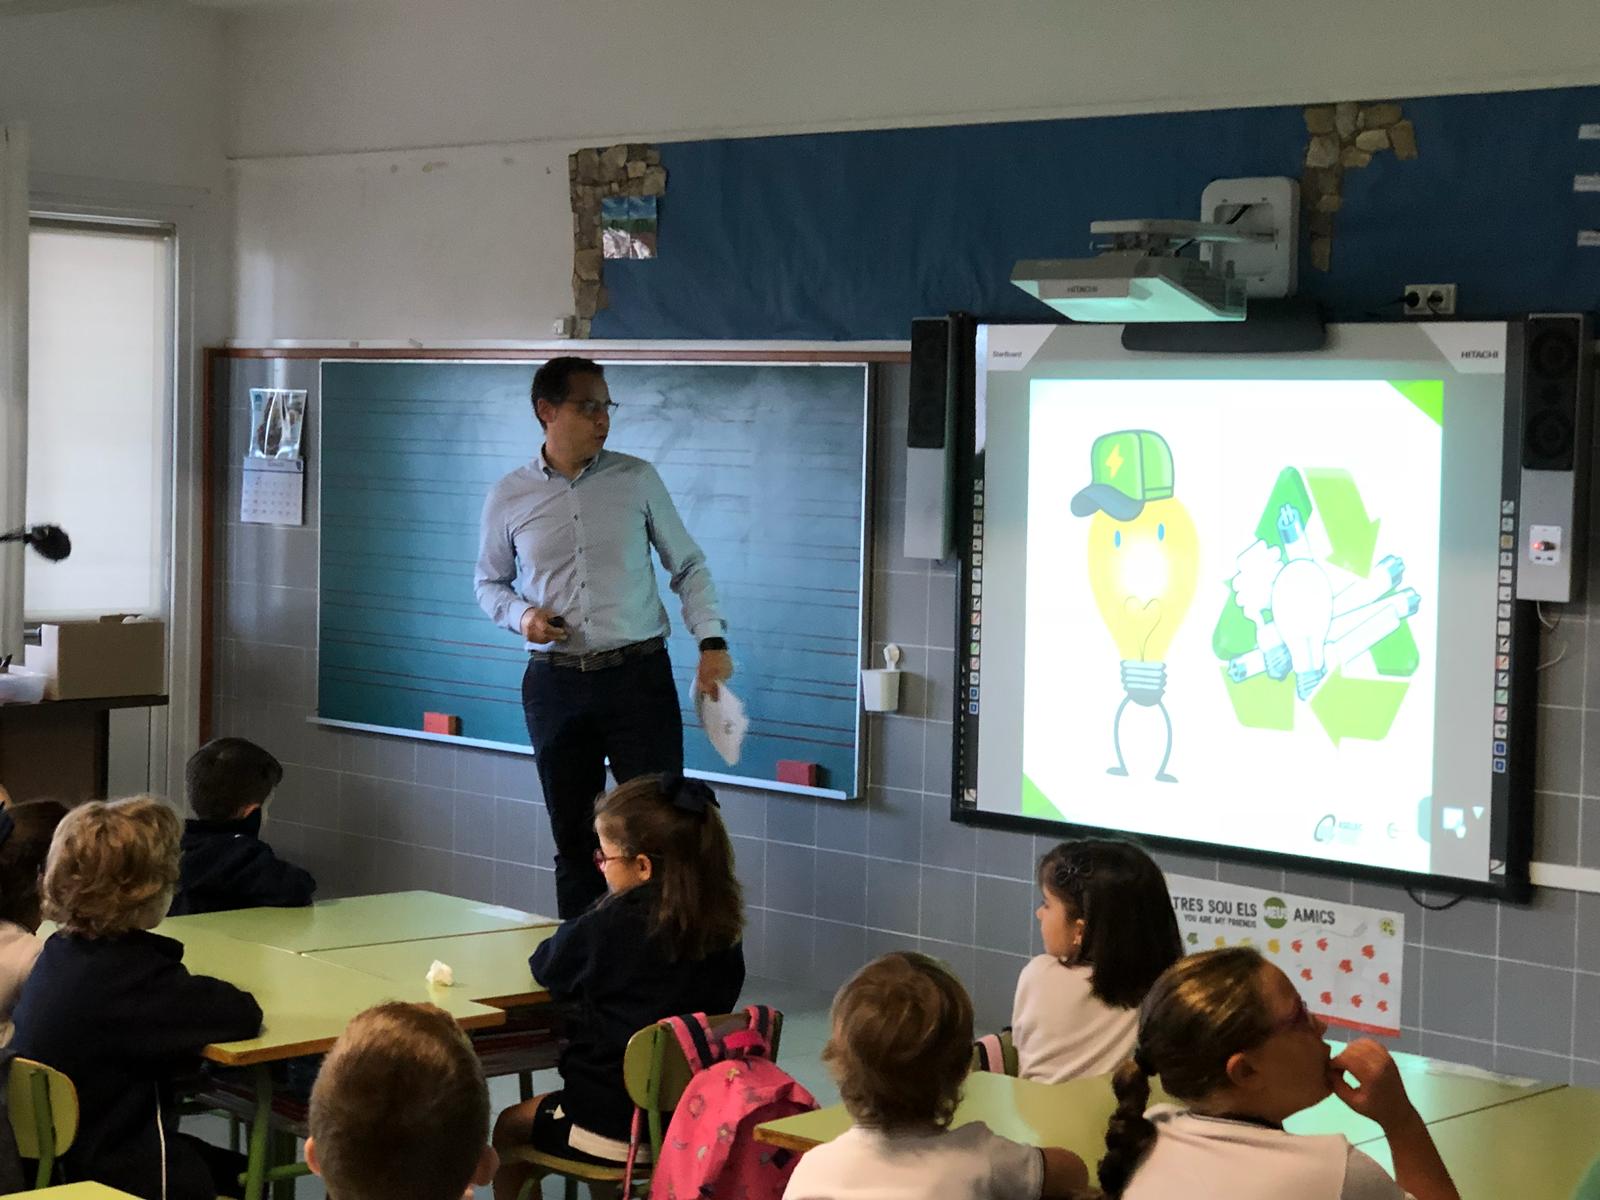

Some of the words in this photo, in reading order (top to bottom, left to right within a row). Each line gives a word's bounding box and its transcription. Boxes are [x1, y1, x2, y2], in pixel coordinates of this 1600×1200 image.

[1461, 350, 1499, 359] HITACHI
[1208, 899, 1232, 915] SOU
[1237, 902, 1257, 917] ELS
[1293, 908, 1336, 925] AMICS
[1184, 914, 1197, 922] YOU
[1199, 915, 1212, 924] ARE
[1215, 916, 1226, 924] MY
